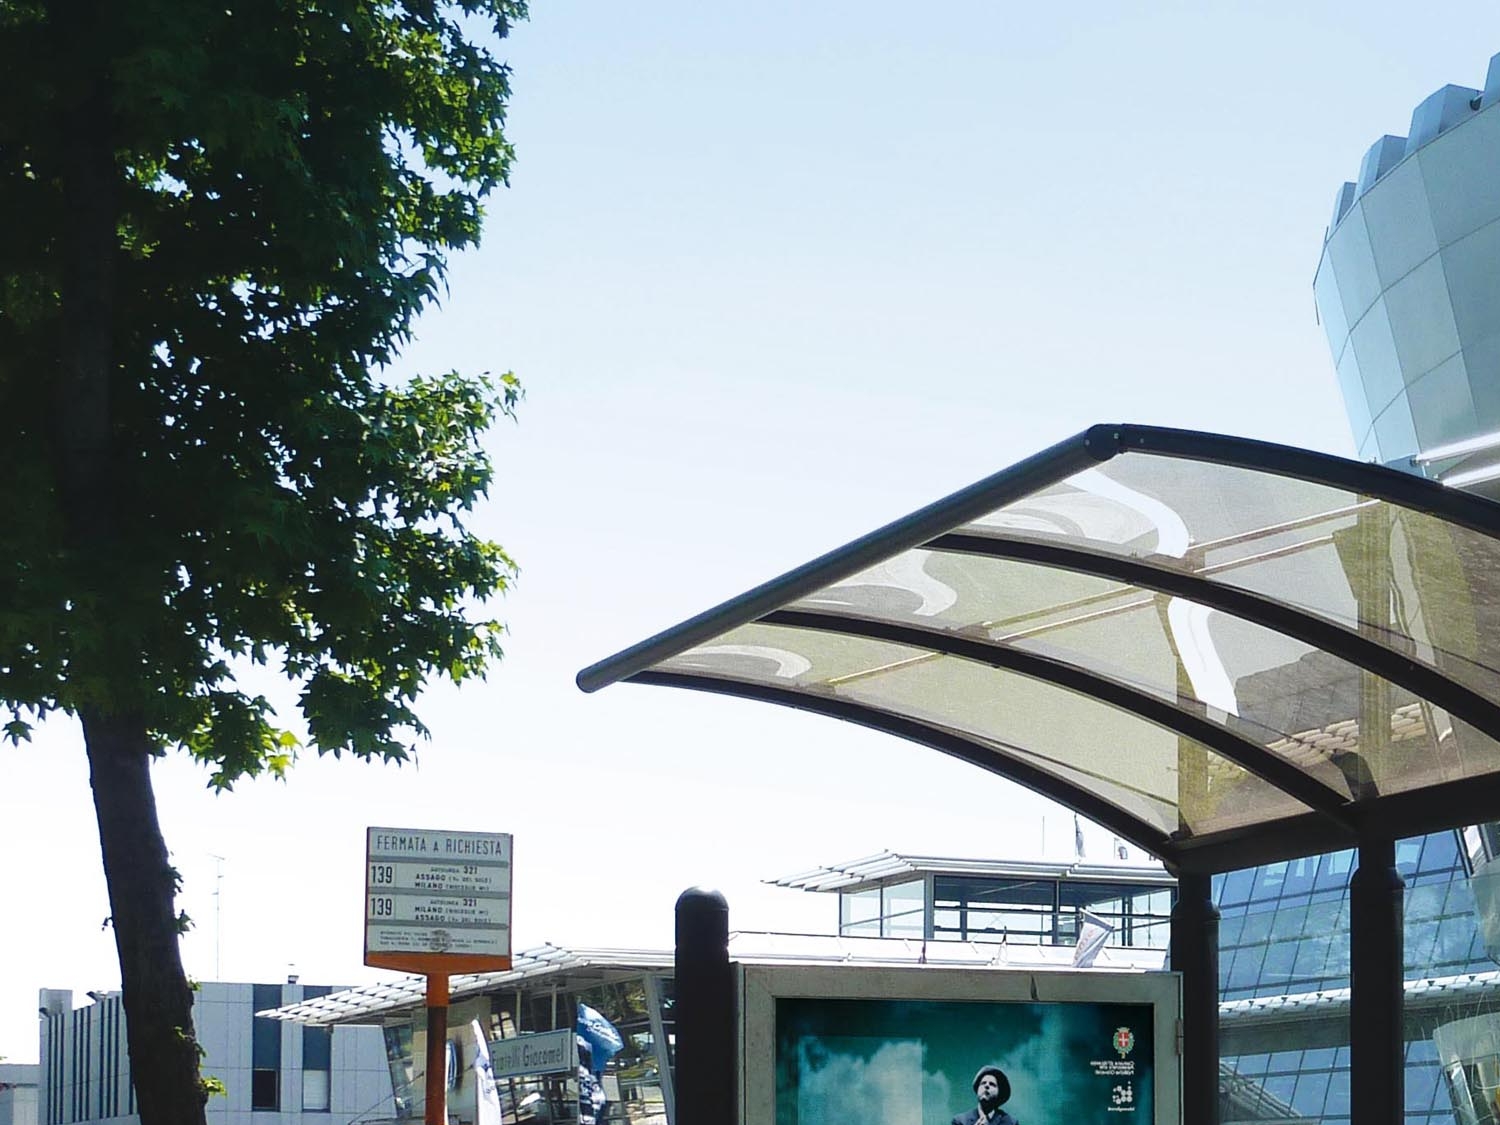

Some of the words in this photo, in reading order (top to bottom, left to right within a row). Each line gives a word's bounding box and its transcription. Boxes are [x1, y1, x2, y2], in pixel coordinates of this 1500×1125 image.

[376, 835, 427, 852] FERMATA
[433, 841, 439, 852] A
[446, 838, 502, 856] RICHIESTA
[371, 865, 393, 884] 139
[416, 873, 446, 881] ASSAGO
[463, 866, 478, 875] 321
[371, 897, 392, 916] 139
[463, 898, 477, 907] 321
[415, 906, 443, 914] MILANO
[523, 1038, 564, 1067] Giacomel
